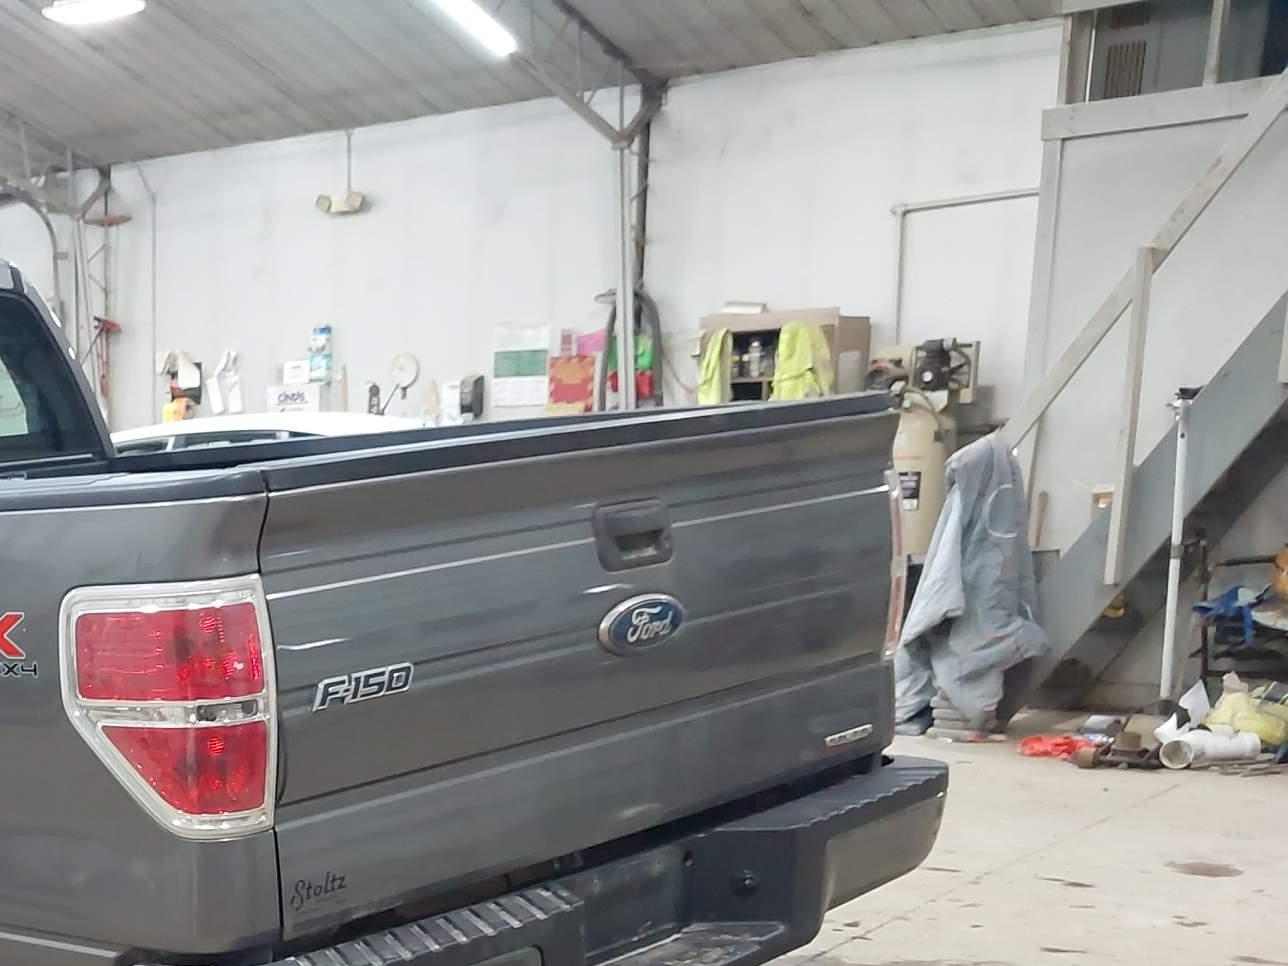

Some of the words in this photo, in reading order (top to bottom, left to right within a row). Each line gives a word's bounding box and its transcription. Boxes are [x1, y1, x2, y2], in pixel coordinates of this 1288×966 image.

[627, 605, 673, 643] Ford
[312, 662, 414, 712] F-150
[290, 871, 347, 911] Stoltz
